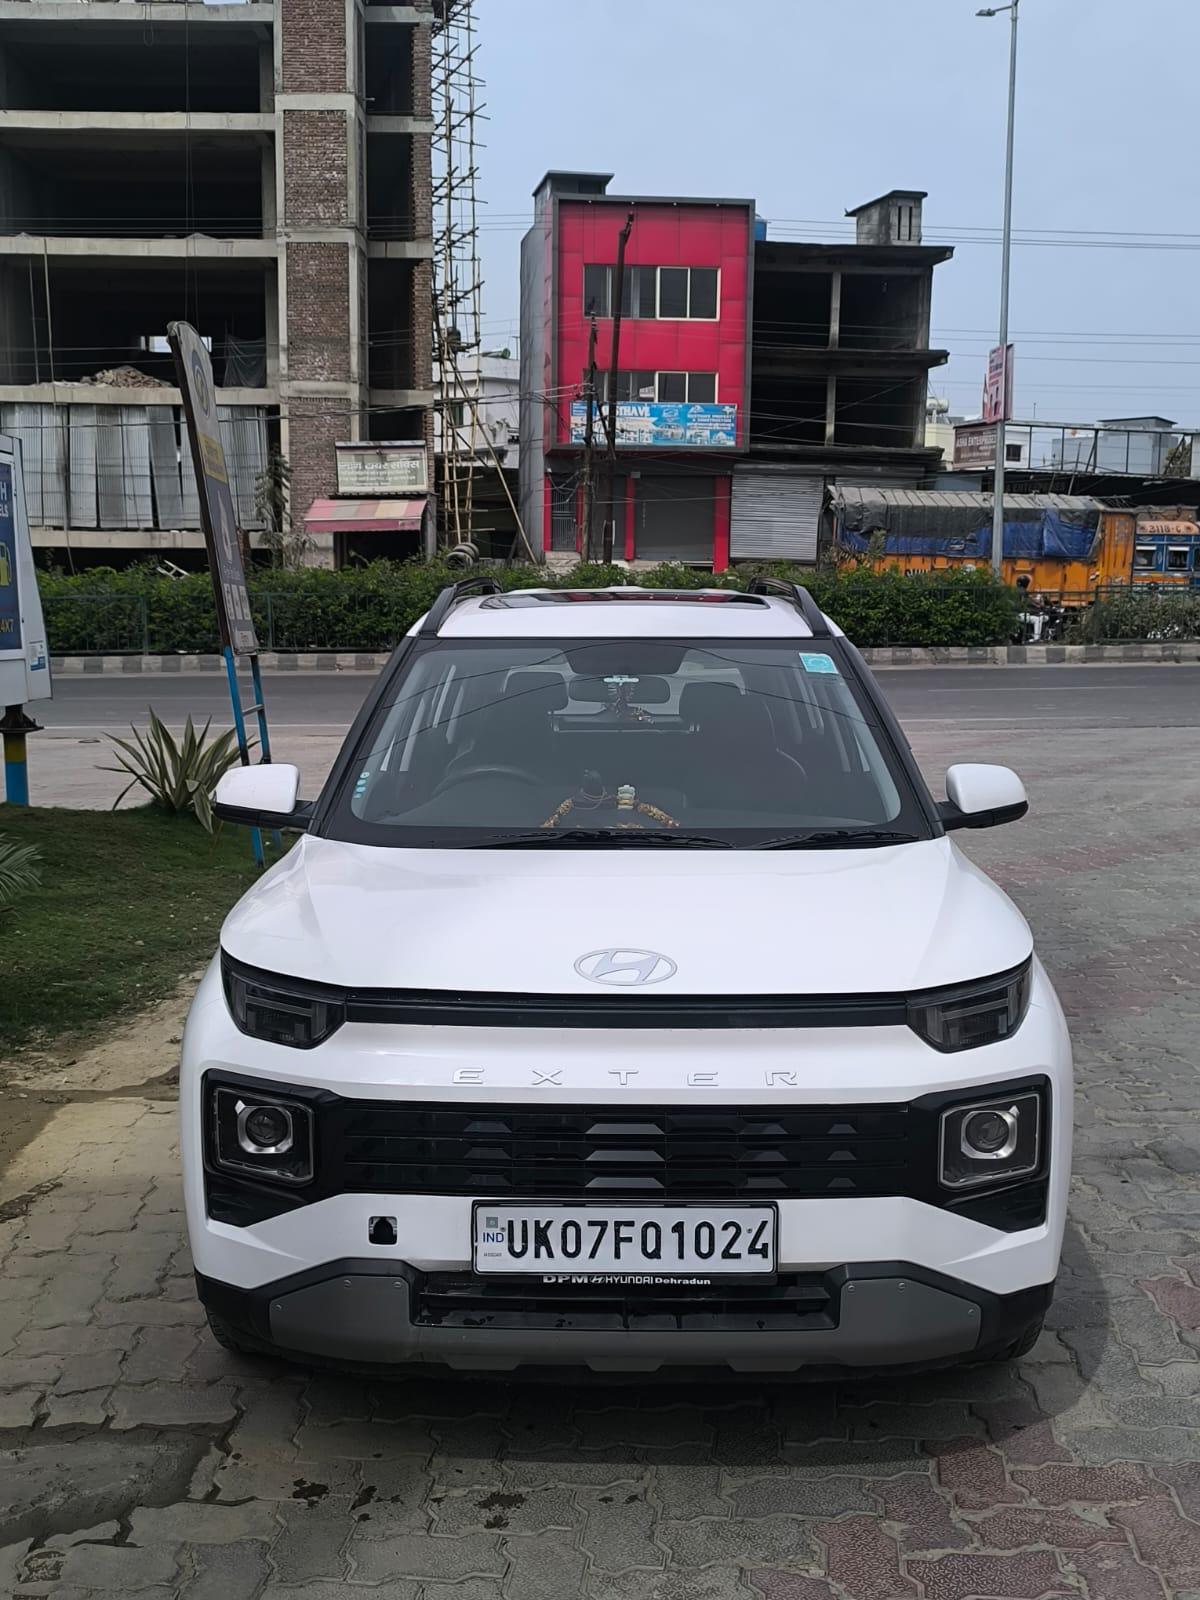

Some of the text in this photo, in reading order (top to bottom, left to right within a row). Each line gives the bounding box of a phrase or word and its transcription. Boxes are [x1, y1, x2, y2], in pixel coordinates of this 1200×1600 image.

[452, 1067, 798, 1087] EXTER
[482, 1231, 505, 1243] IND
[507, 1219, 769, 1260] UK07FQ1024
[542, 1275, 711, 1285] DPM HYUNDAI Dehradun
